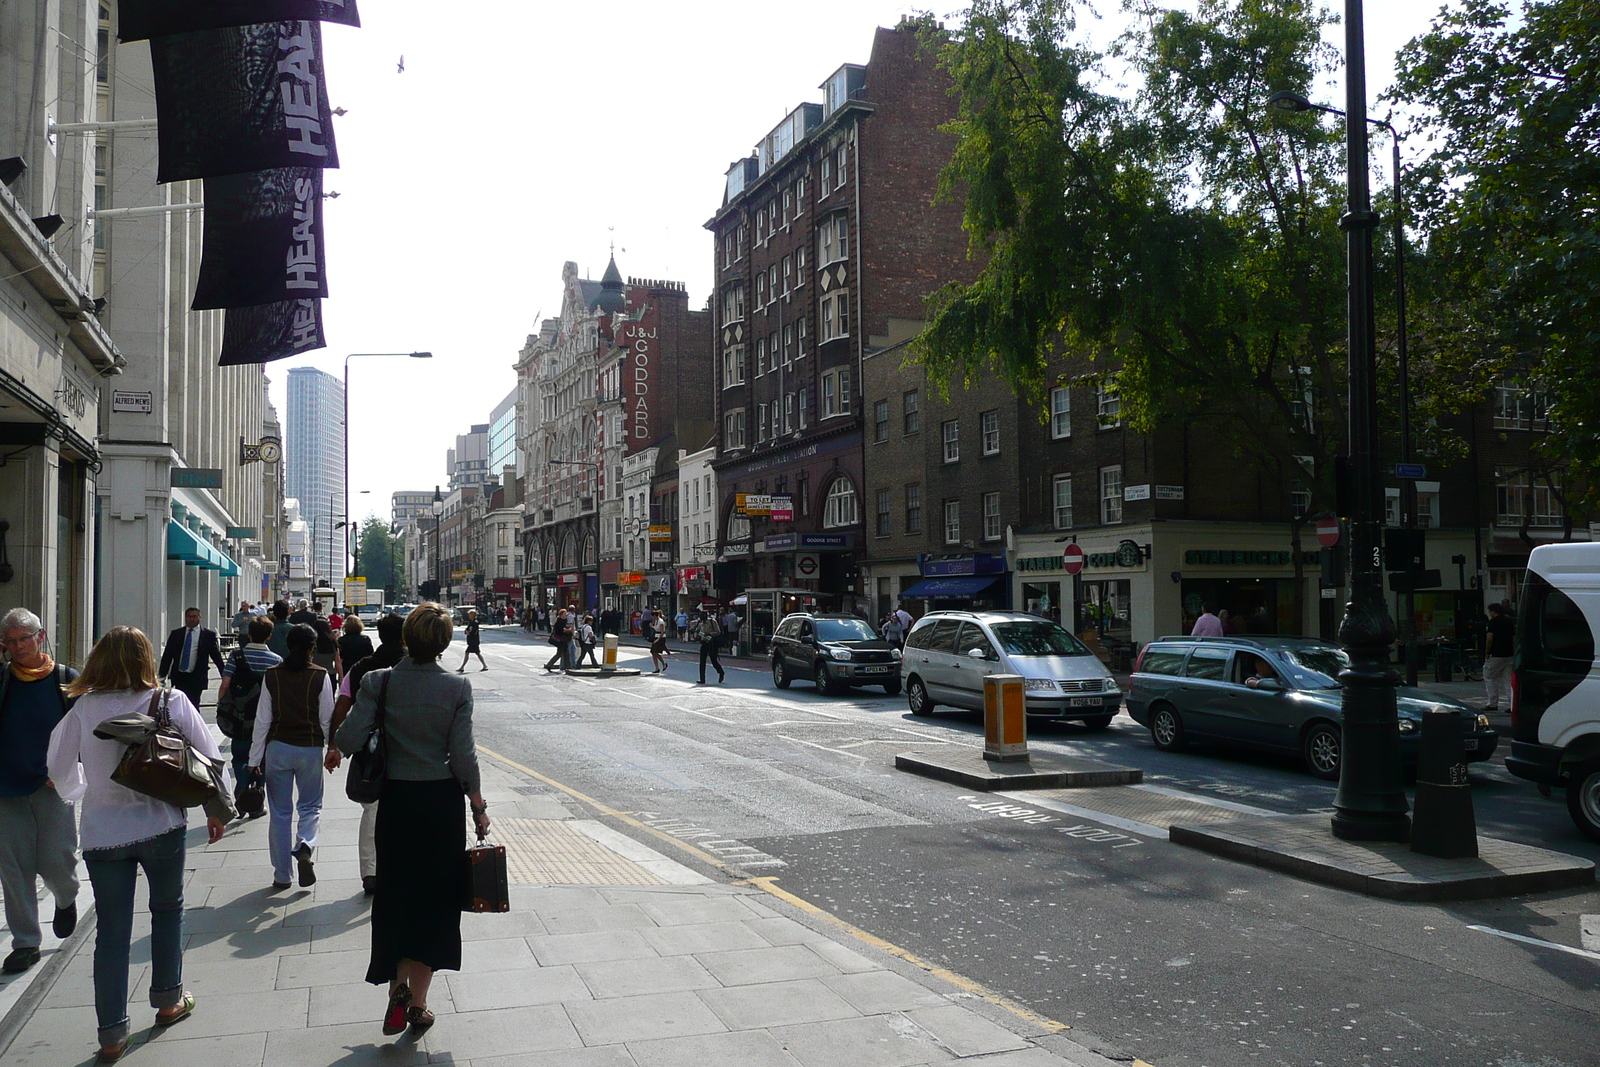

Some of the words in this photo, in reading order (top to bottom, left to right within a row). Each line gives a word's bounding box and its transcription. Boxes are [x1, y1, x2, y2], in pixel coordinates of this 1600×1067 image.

[277, 20, 328, 156] HEAL'
[286, 177, 319, 289] HEAL'S
[794, 444, 818, 460] STATION
[1015, 553, 1088, 572] STARBU
[1185, 551, 1291, 565] STARBUCKS
[1053, 823, 1145, 849] LOOK
